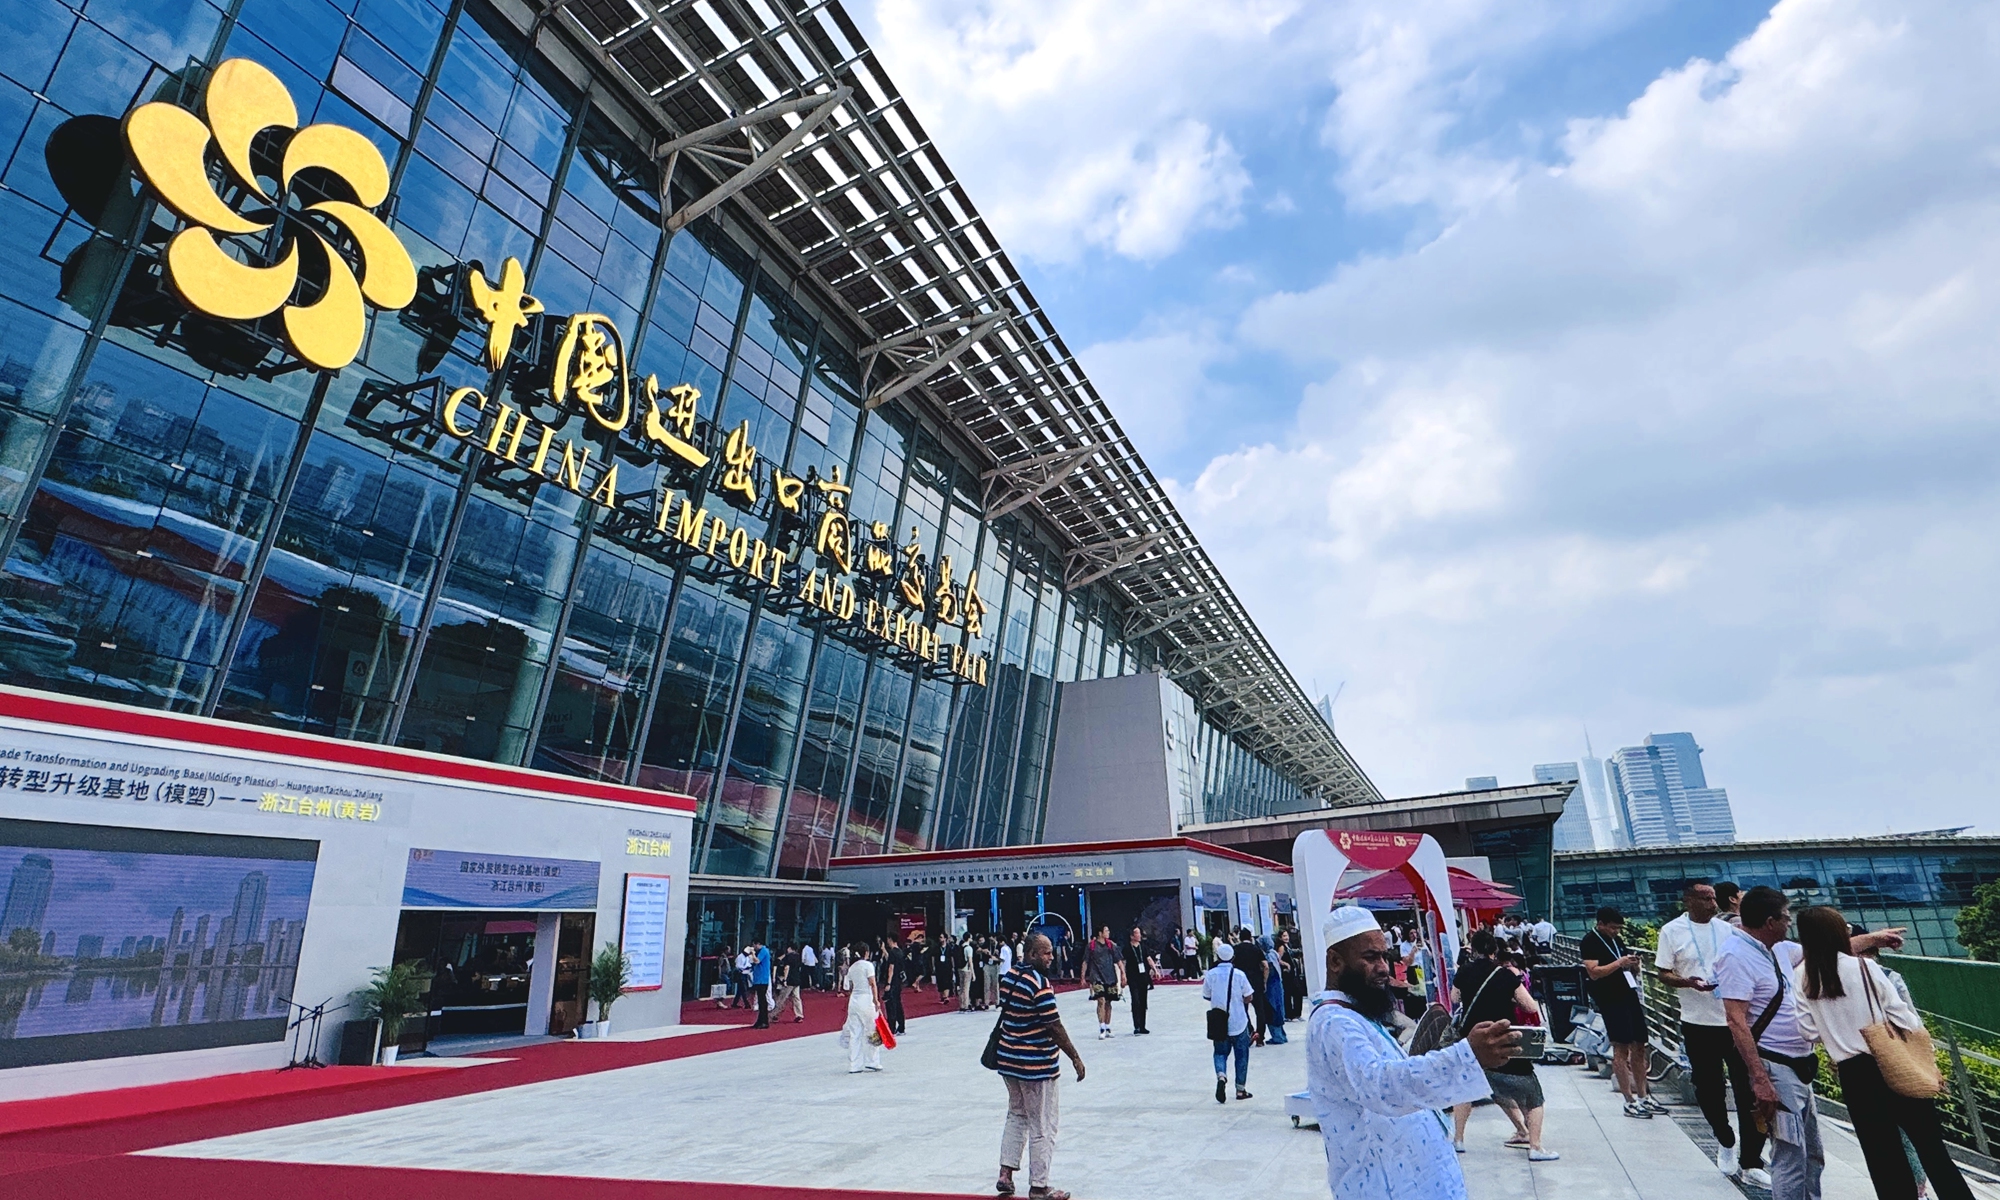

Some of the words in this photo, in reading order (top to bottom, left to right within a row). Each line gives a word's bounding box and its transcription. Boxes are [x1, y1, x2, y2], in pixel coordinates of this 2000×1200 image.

[443, 386, 619, 510] CHINA
[655, 488, 786, 590] IMPORT
[798, 567, 856, 621] AND
[865, 598, 942, 664] EXPORT
[951, 642, 988, 687] FAIR
[0, 748, 21, 760] ade
[24, 750, 107, 770] Transformation
[108, 762, 129, 772] and
[130, 762, 180, 780] Upgrading
[626, 837, 671, 858] 浙江台州
